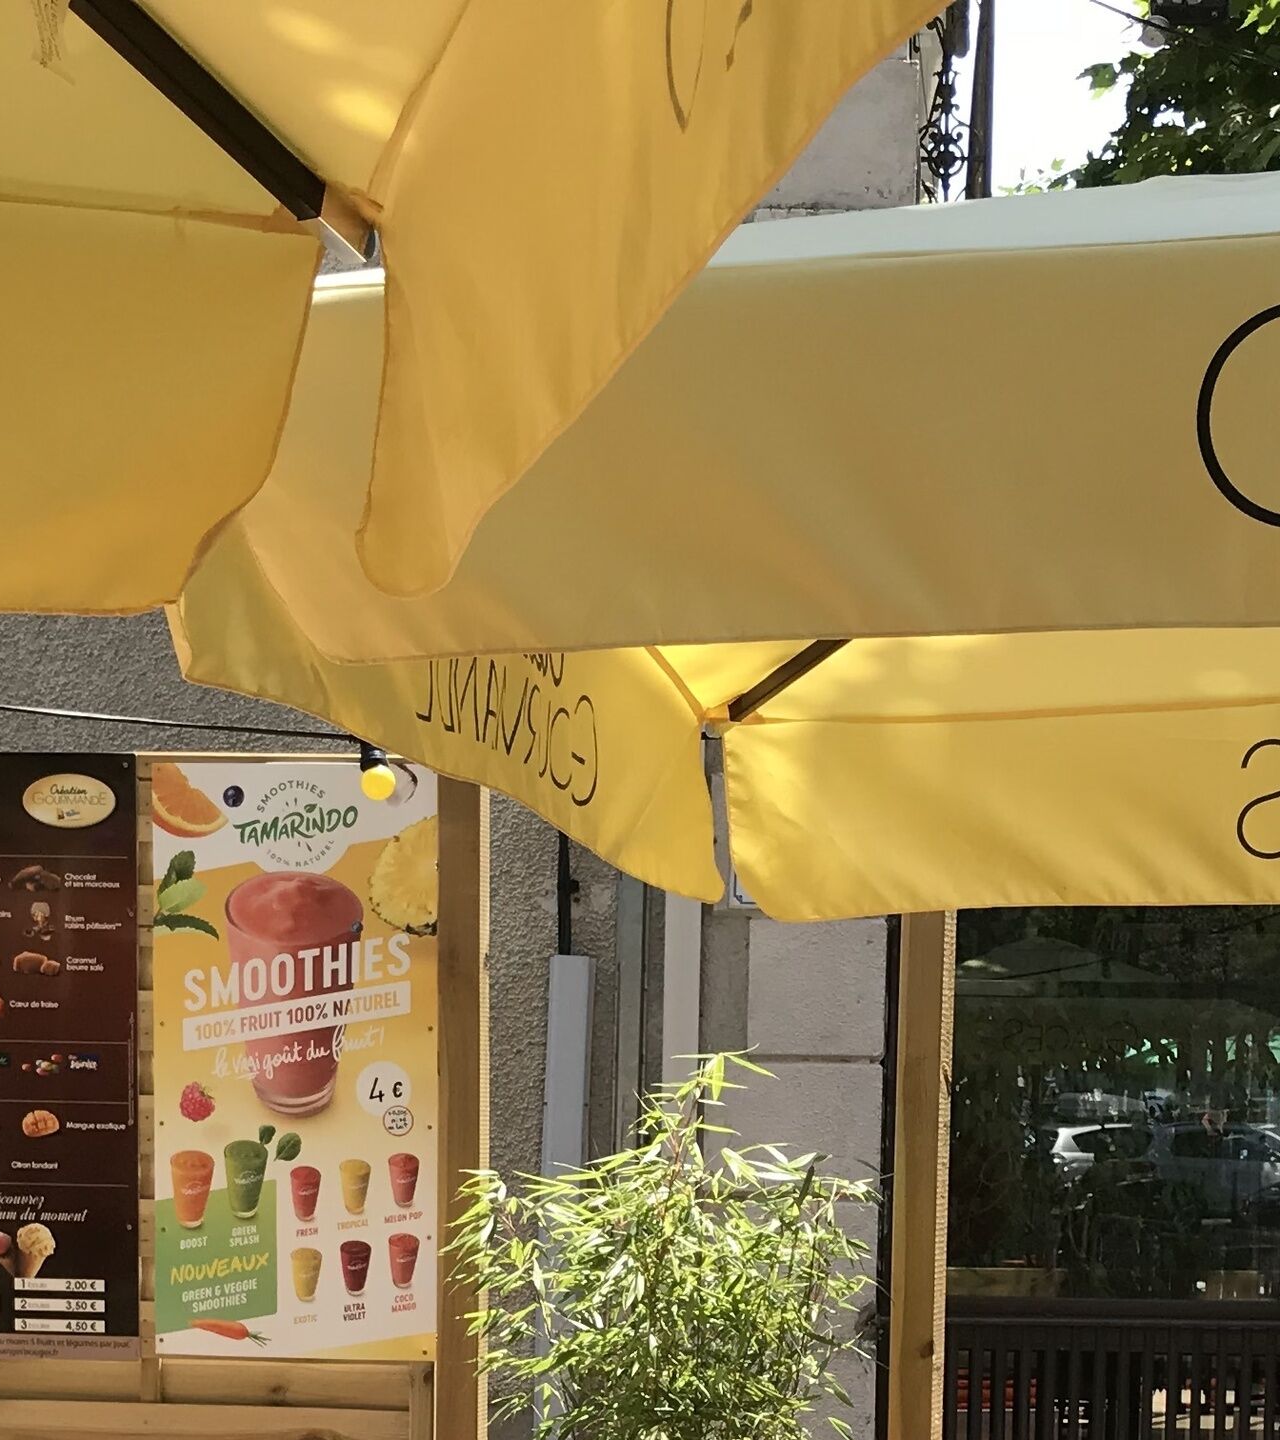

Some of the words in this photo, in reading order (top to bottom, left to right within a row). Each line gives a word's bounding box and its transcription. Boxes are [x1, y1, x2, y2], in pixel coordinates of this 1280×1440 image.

[50, 784, 88, 795] Création
[256, 780, 326, 813] SMOOTHIES
[295, 840, 335, 867] NATUREL
[64, 872, 97, 881] Chocolat
[66, 956, 97, 964] Caramel
[184, 933, 411, 1012] SMOOTHIES
[195, 1017, 236, 1041] 100%
[240, 1010, 282, 1034] FRUIT
[286, 1003, 328, 1025] 100%
[333, 990, 400, 1017] NATUREL
[306, 1039, 331, 1062] du
[369, 1077, 385, 1102] 4
[393, 1081, 403, 1098] €
[66, 1121, 95, 1131] Mangue
[20, 1207, 36, 1221] du
[40, 1208, 88, 1222] moment
[384, 1214, 408, 1224] MELON
[409, 1211, 424, 1221] POP
[231, 1225, 257, 1237] GREEN
[296, 1227, 319, 1238] FRESH
[180, 1236, 209, 1250] BOOST
[229, 1235, 260, 1248] SPLASH
[170, 1252, 270, 1286] NOUVEAUX
[21, 1279, 26, 1289] 1
[65, 1280, 87, 1291] 2,00
[90, 1281, 97, 1291] €
[182, 1287, 212, 1303] GREEN
[224, 1279, 258, 1296] VEGGIE
[192, 1293, 248, 1313] SMOOTHIES
[395, 1293, 414, 1304] COCO
[20, 1299, 28, 1309] 2
[65, 1300, 88, 1312] 3,50
[90, 1301, 97, 1311] €
[344, 1303, 366, 1313] ULTRA
[391, 1302, 417, 1313] MANGO
[293, 1314, 318, 1325] EXOTIC
[343, 1311, 366, 1322] VIOLET
[20, 1319, 28, 1330] 3
[65, 1321, 88, 1333] 4,50
[90, 1322, 97, 1331] €
